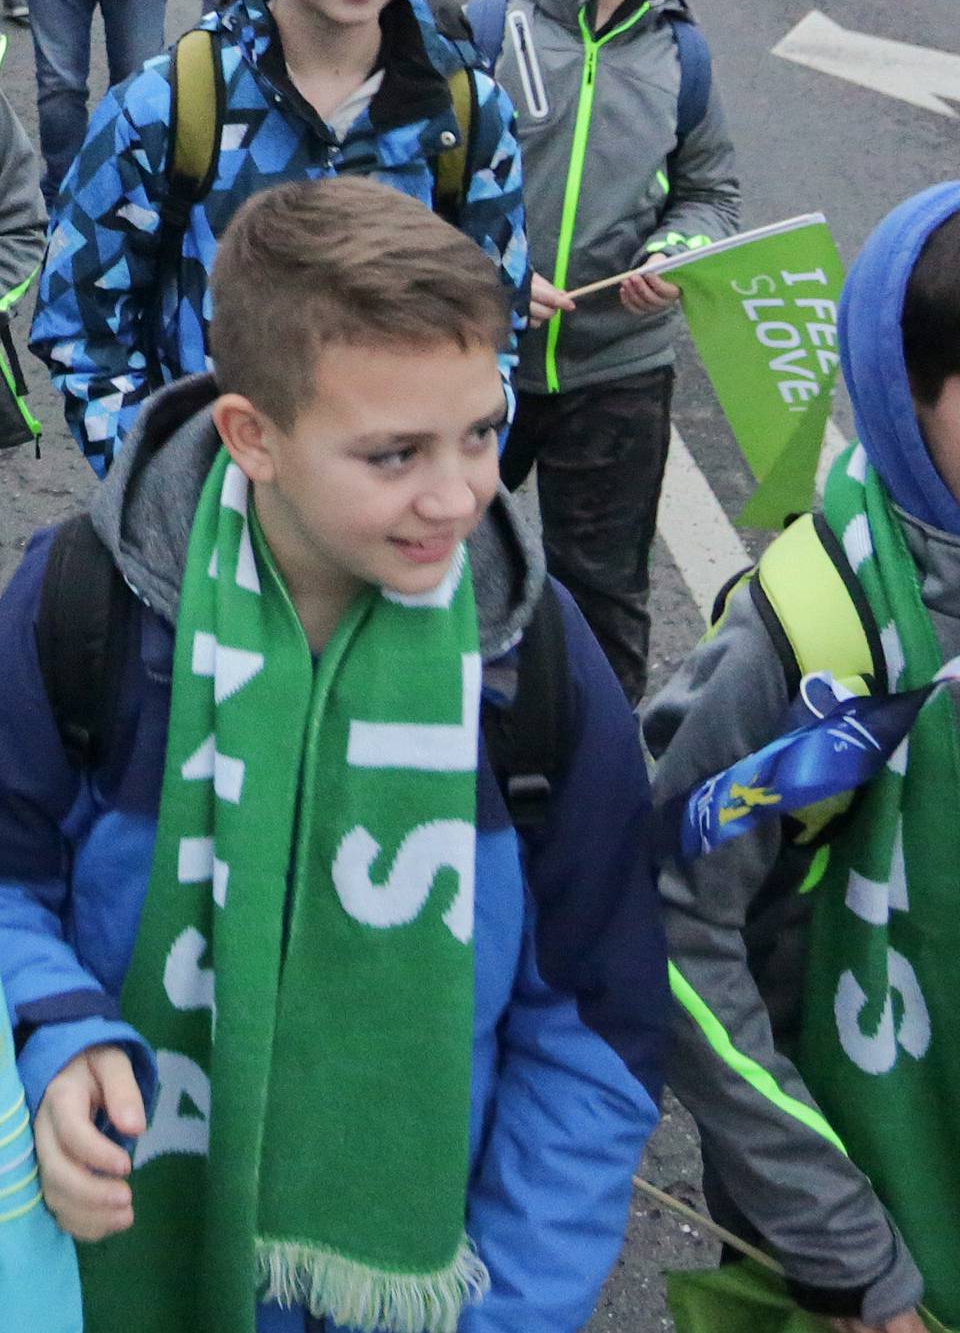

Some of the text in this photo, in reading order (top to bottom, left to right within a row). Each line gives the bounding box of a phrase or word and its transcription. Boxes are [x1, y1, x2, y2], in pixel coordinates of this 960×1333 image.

[730, 274, 821, 411] SLOVE
[780, 267, 840, 375] I FEE
